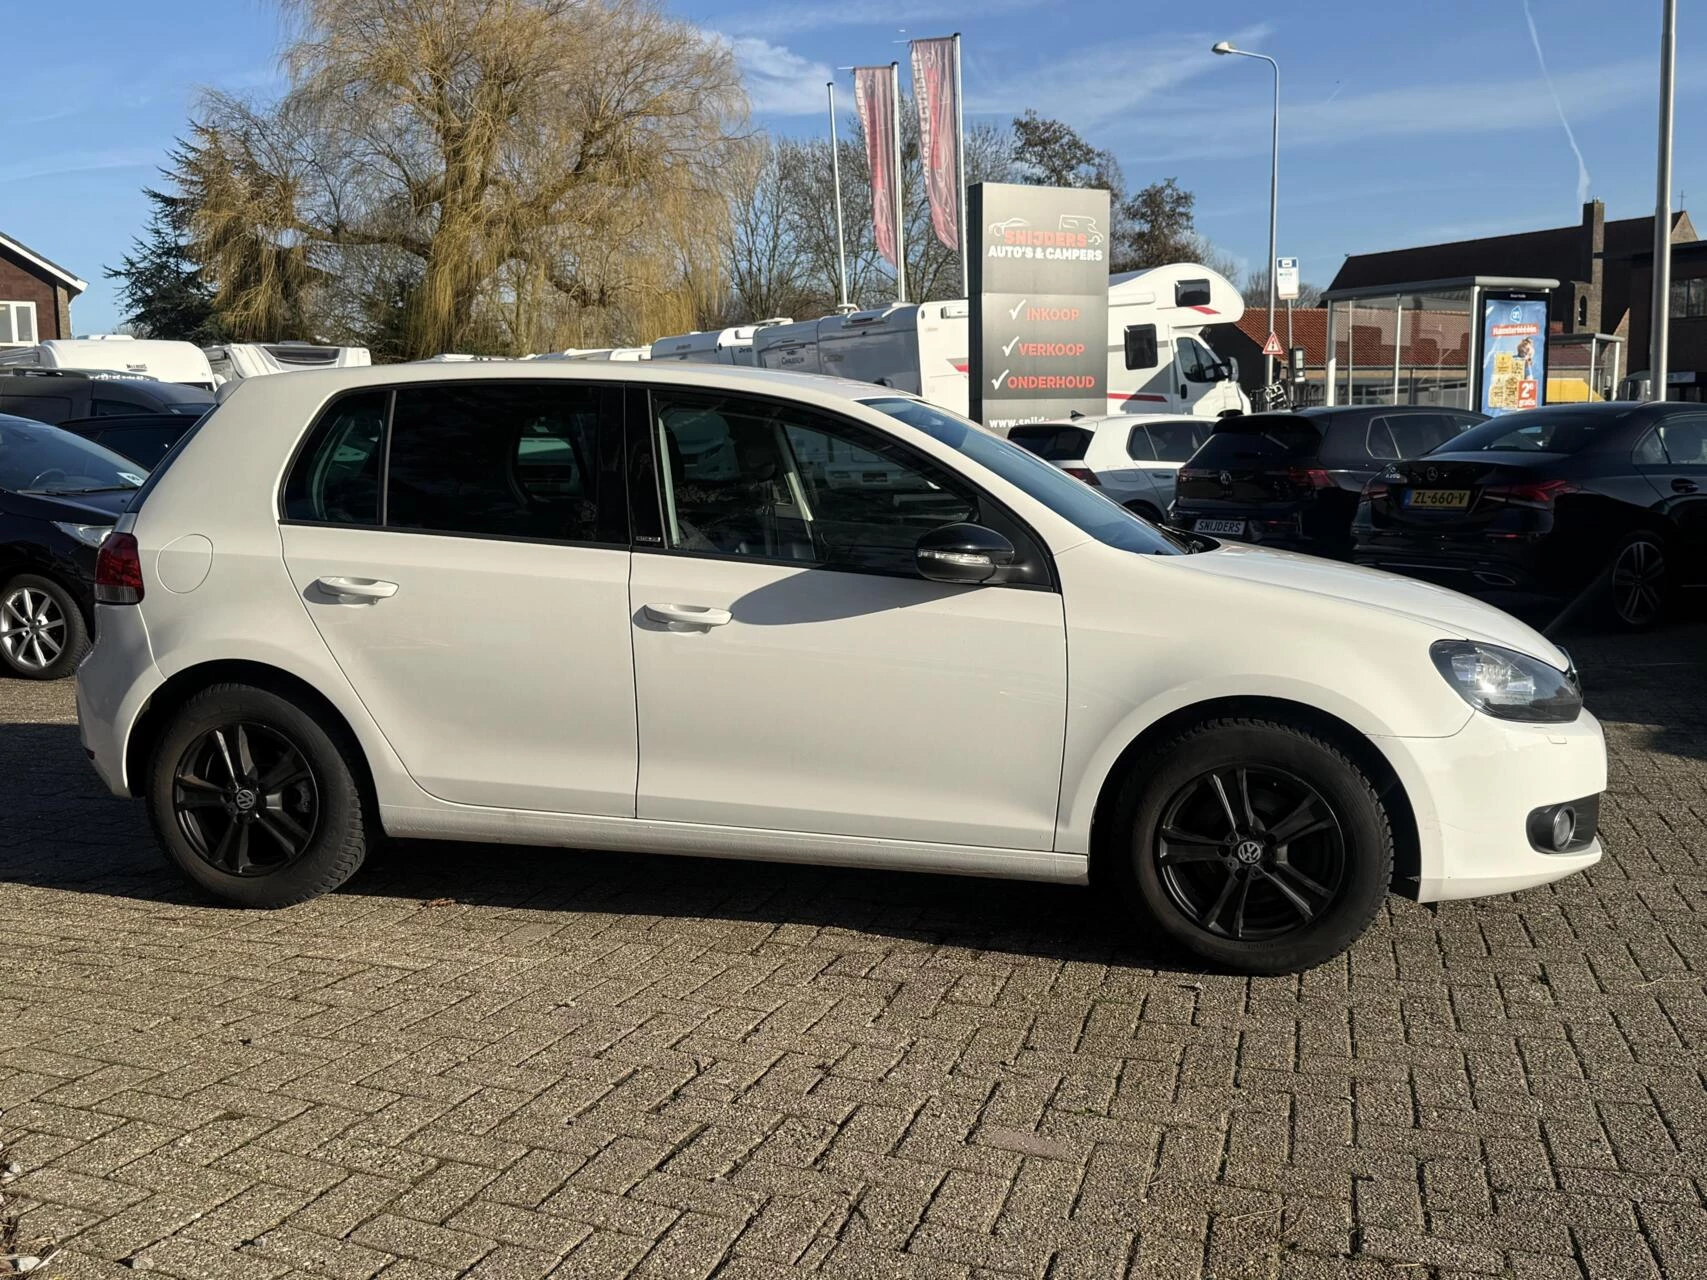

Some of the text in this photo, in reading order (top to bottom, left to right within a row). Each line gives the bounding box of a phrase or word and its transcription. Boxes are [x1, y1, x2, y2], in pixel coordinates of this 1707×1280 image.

[1004, 231, 1087, 247] SNIJDERS
[988, 245, 1103, 261] AUTO'S & CAMPERS
[1027, 307, 1080, 321] INKOOP
[1018, 343, 1085, 356] VERKOOP
[1007, 376, 1095, 389] ONDERHOUD
[1413, 490, 1467, 505] ZL-660-V
[1199, 520, 1241, 533] SNIJDERS
